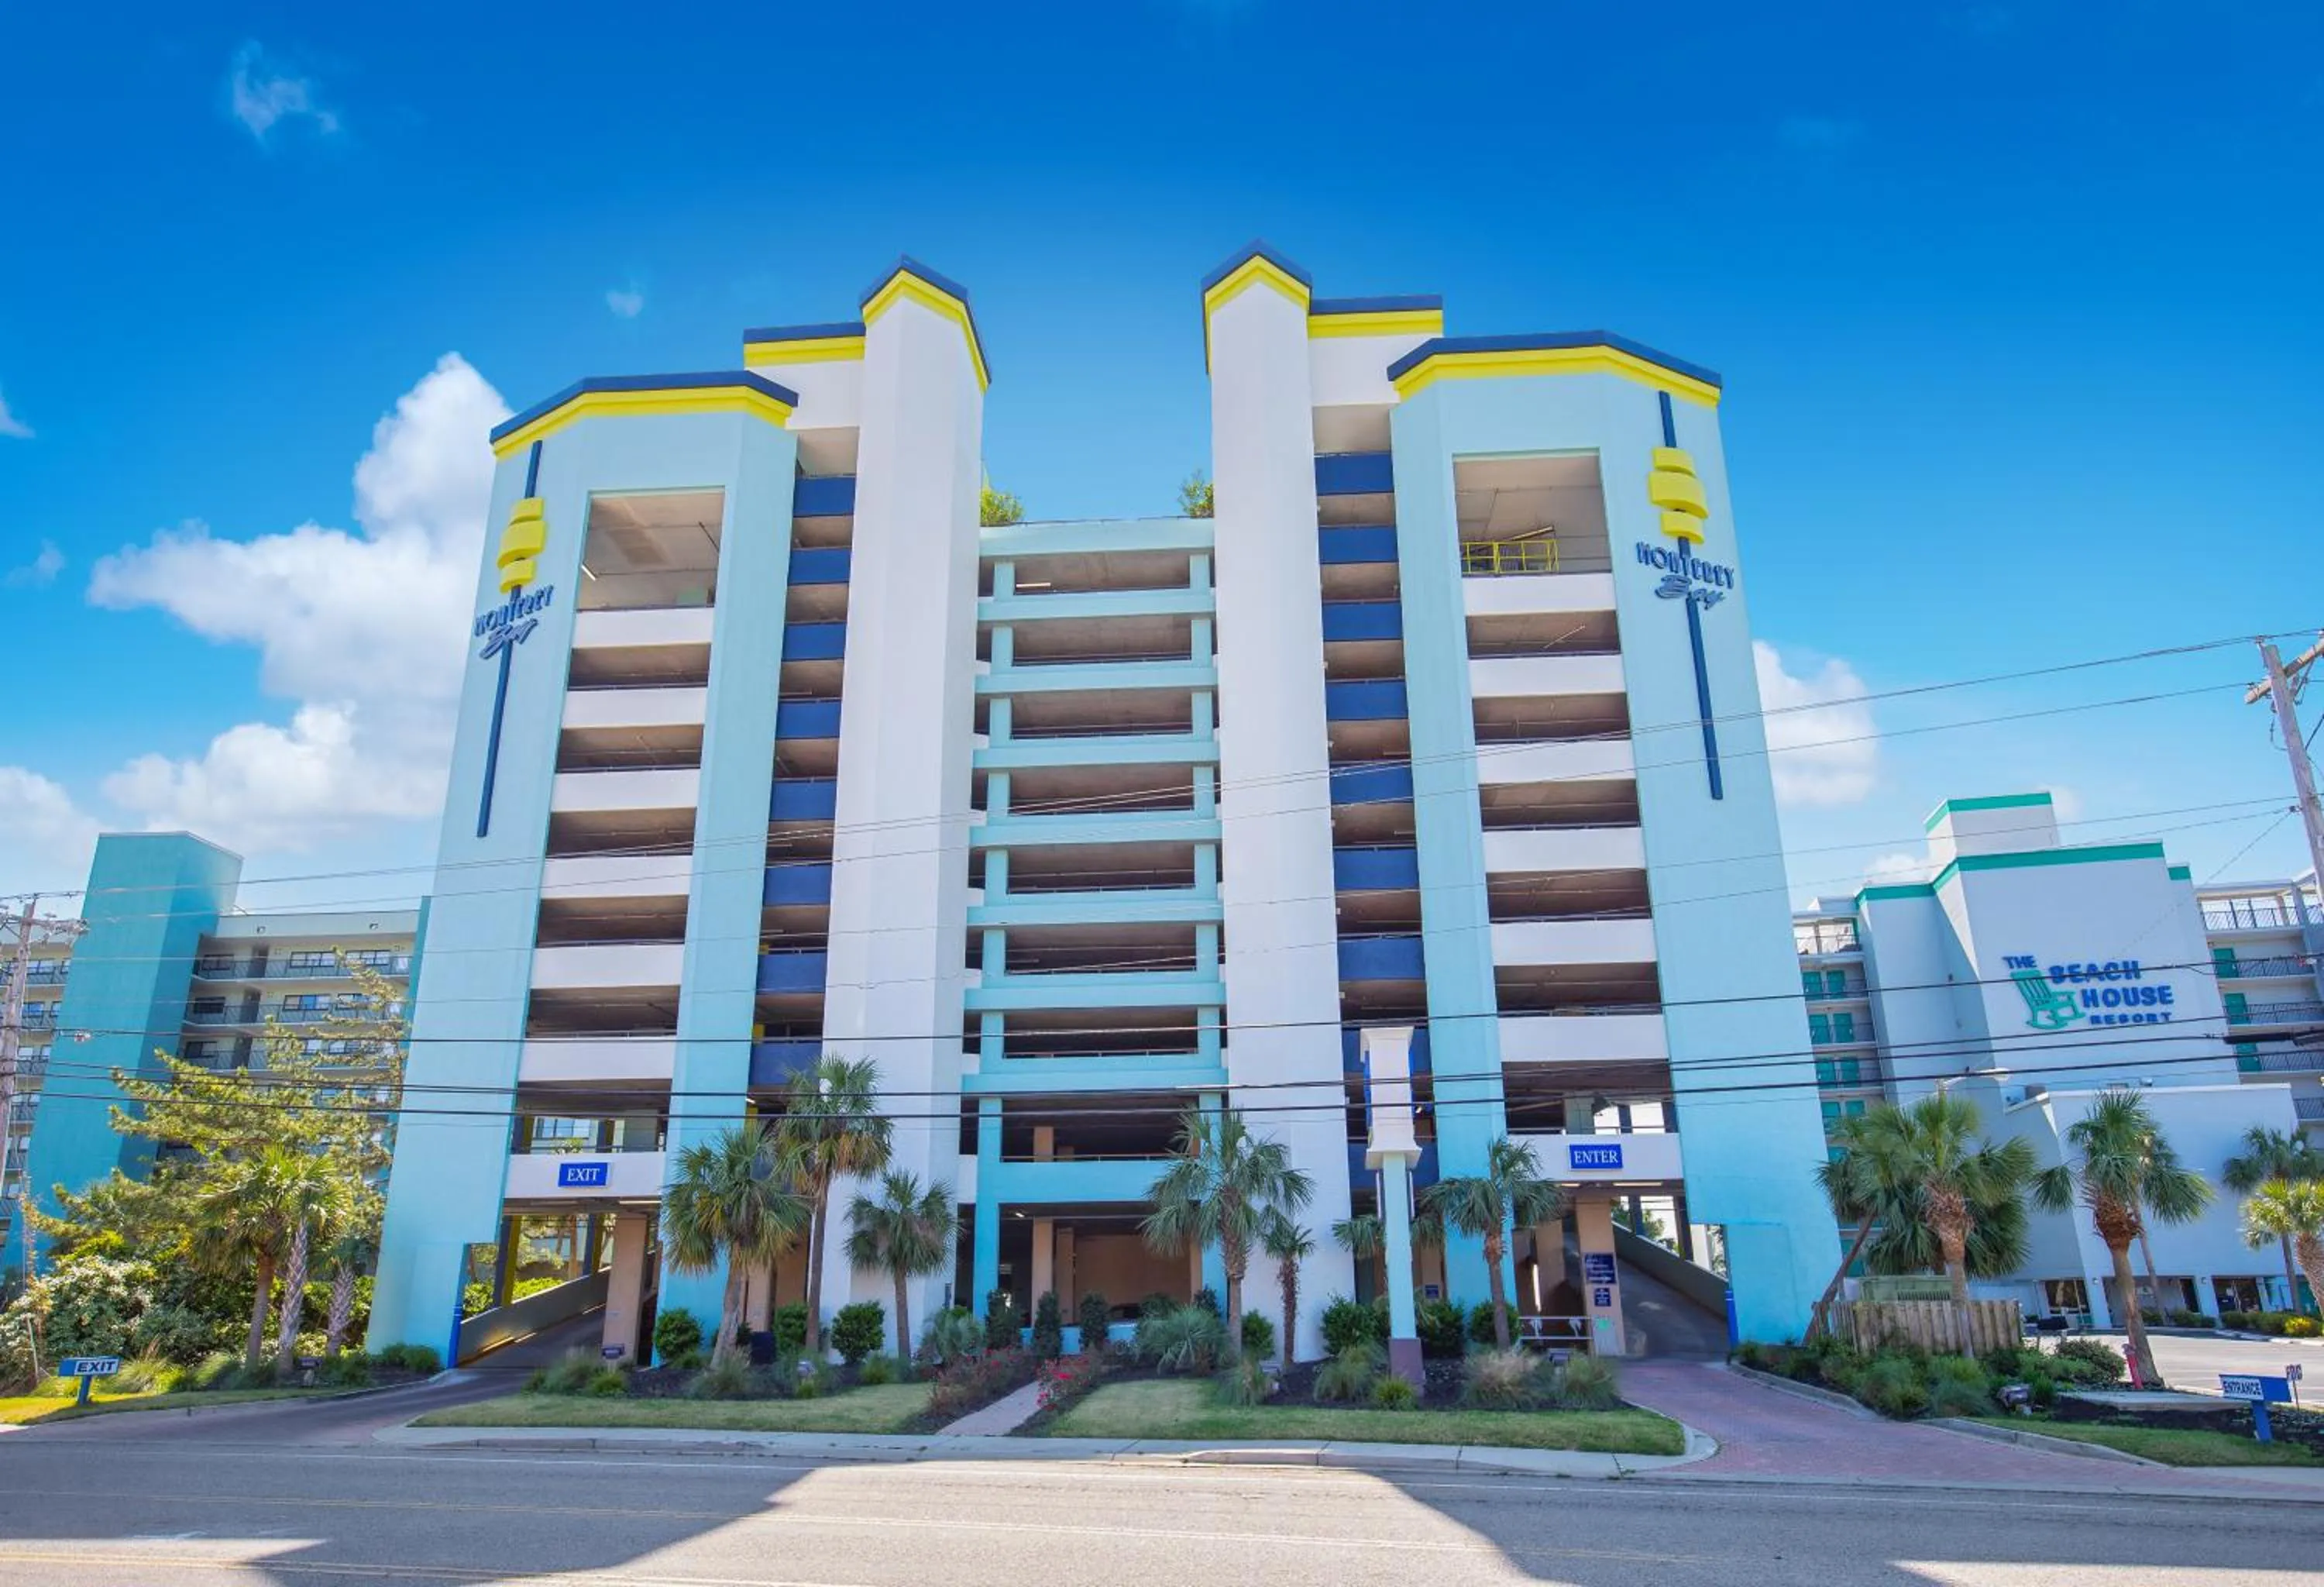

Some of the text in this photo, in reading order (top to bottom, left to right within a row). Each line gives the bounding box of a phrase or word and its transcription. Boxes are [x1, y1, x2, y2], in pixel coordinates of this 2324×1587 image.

[2003, 955, 2037, 969] THE
[2047, 960, 2142, 984] BEACH
[2081, 985, 2174, 1008] HOUSE
[2089, 1012, 2172, 1025] RESORT
[1573, 1150, 1619, 1164] ENTER
[566, 1168, 600, 1182] EXIT
[77, 1361, 118, 1373] EXIT
